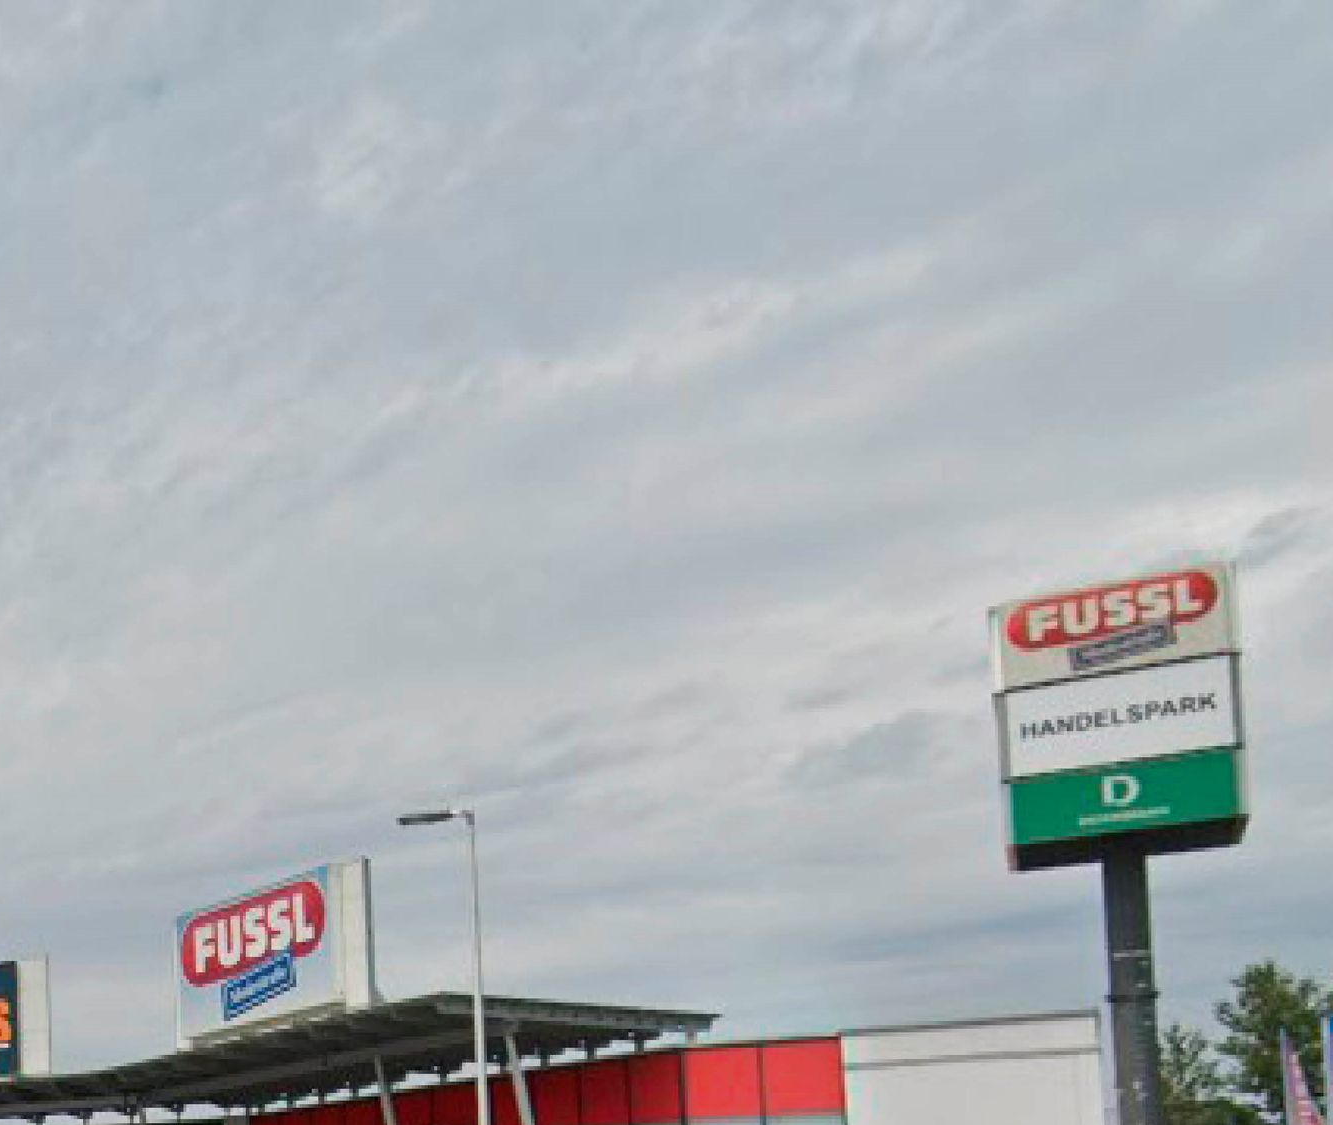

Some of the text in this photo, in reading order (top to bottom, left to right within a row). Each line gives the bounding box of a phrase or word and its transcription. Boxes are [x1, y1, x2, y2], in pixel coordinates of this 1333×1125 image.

[1027, 579, 1201, 641] FUSSL
[1020, 692, 1217, 739] HANDELSPARK
[1101, 775, 1140, 806] D
[195, 892, 316, 973] FUSSL
